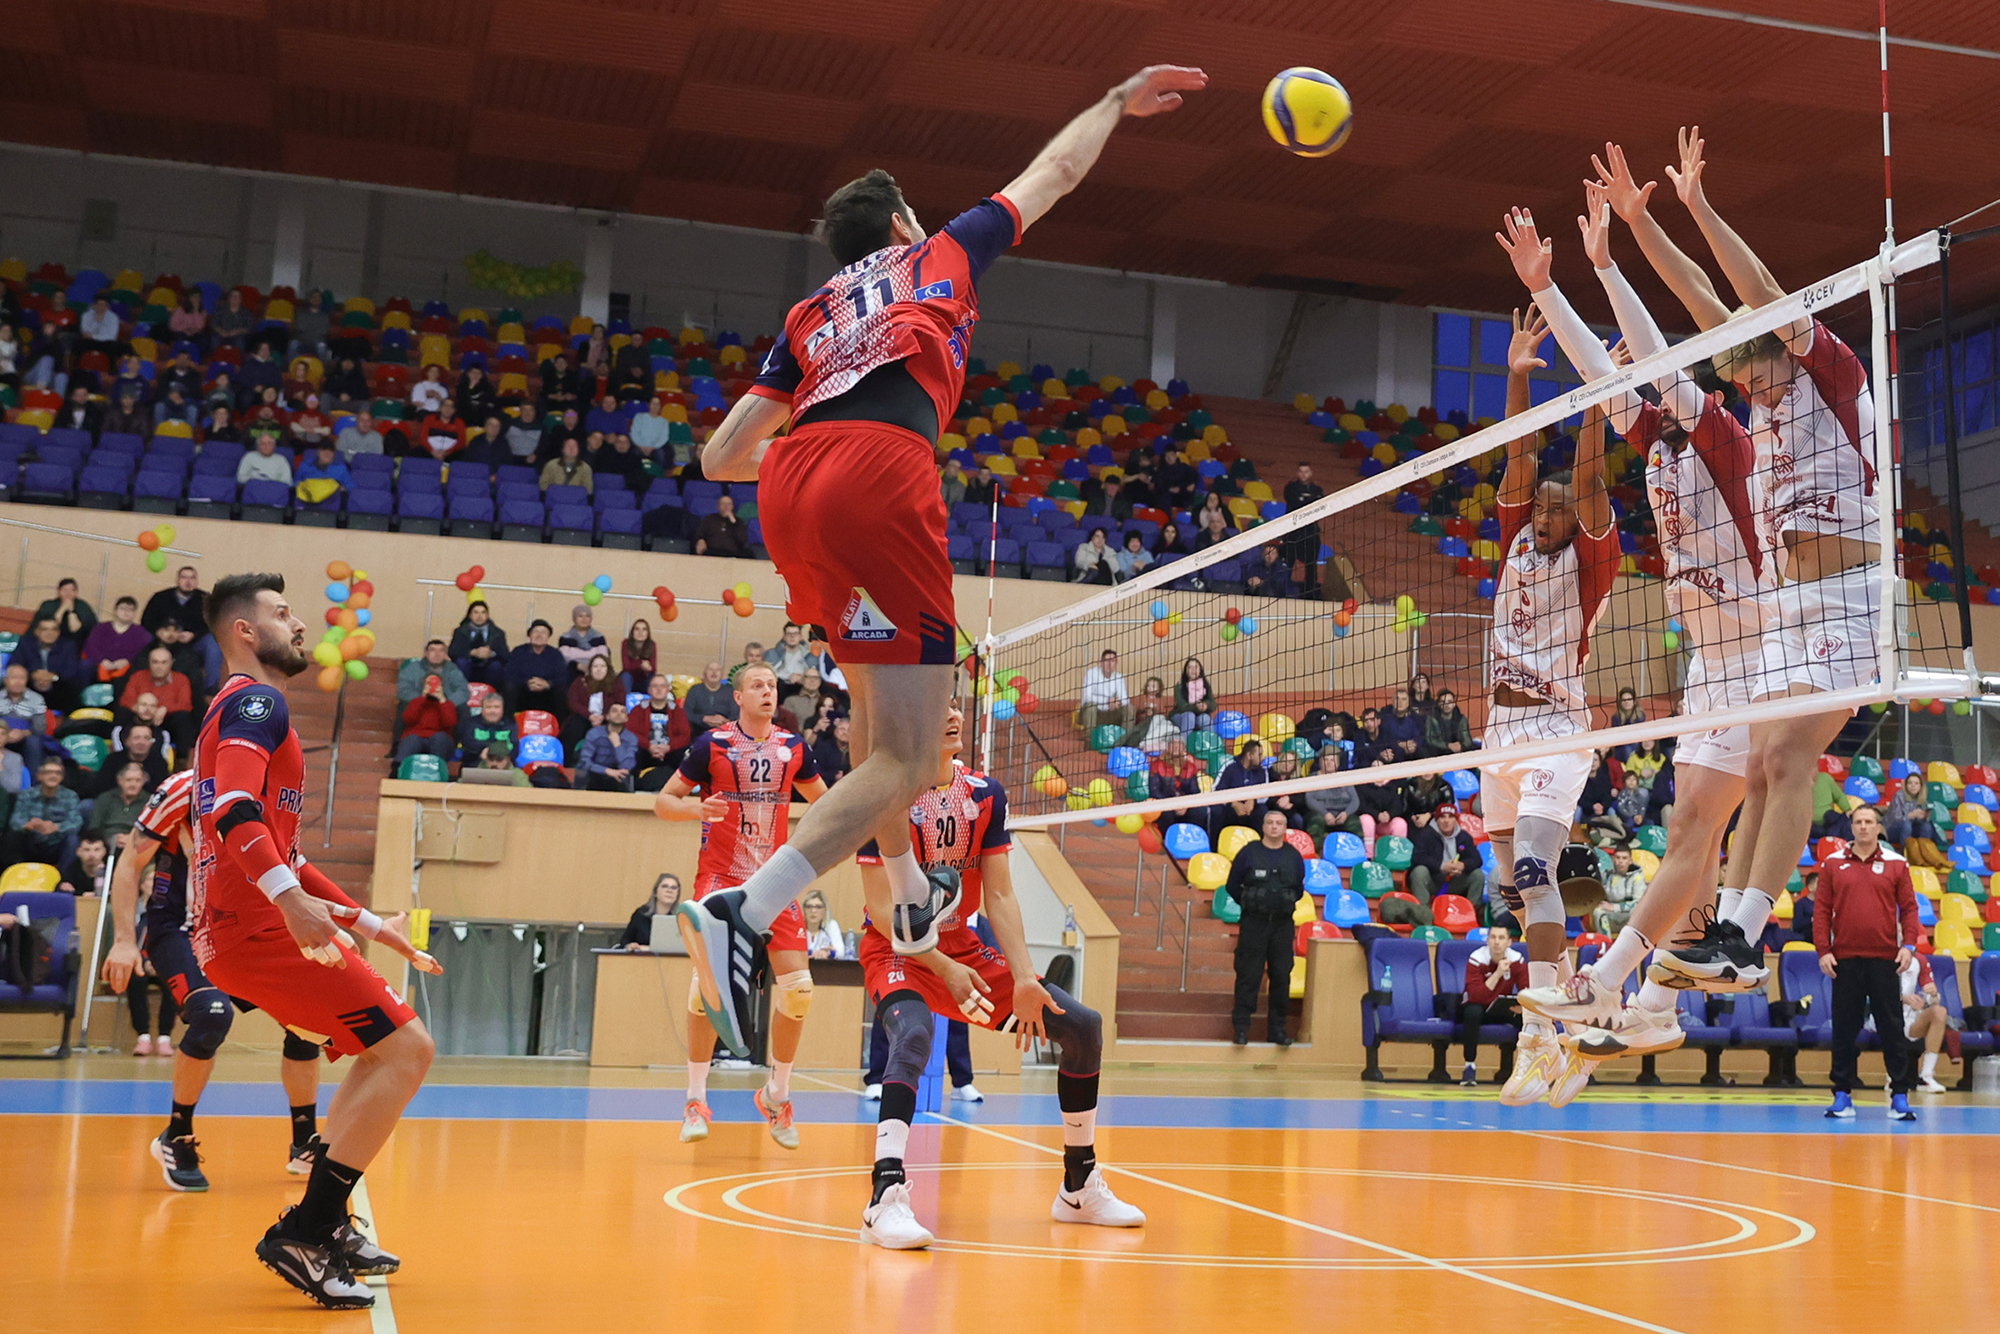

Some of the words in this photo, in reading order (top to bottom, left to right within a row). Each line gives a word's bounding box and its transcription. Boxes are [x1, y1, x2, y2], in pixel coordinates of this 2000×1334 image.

[845, 276, 895, 320] 11
[1816, 282, 1835, 301] CEV
[1654, 486, 1681, 518] 20
[851, 631, 888, 639] ARCADA
[749, 758, 772, 783] 22
[935, 815, 957, 849] 20
